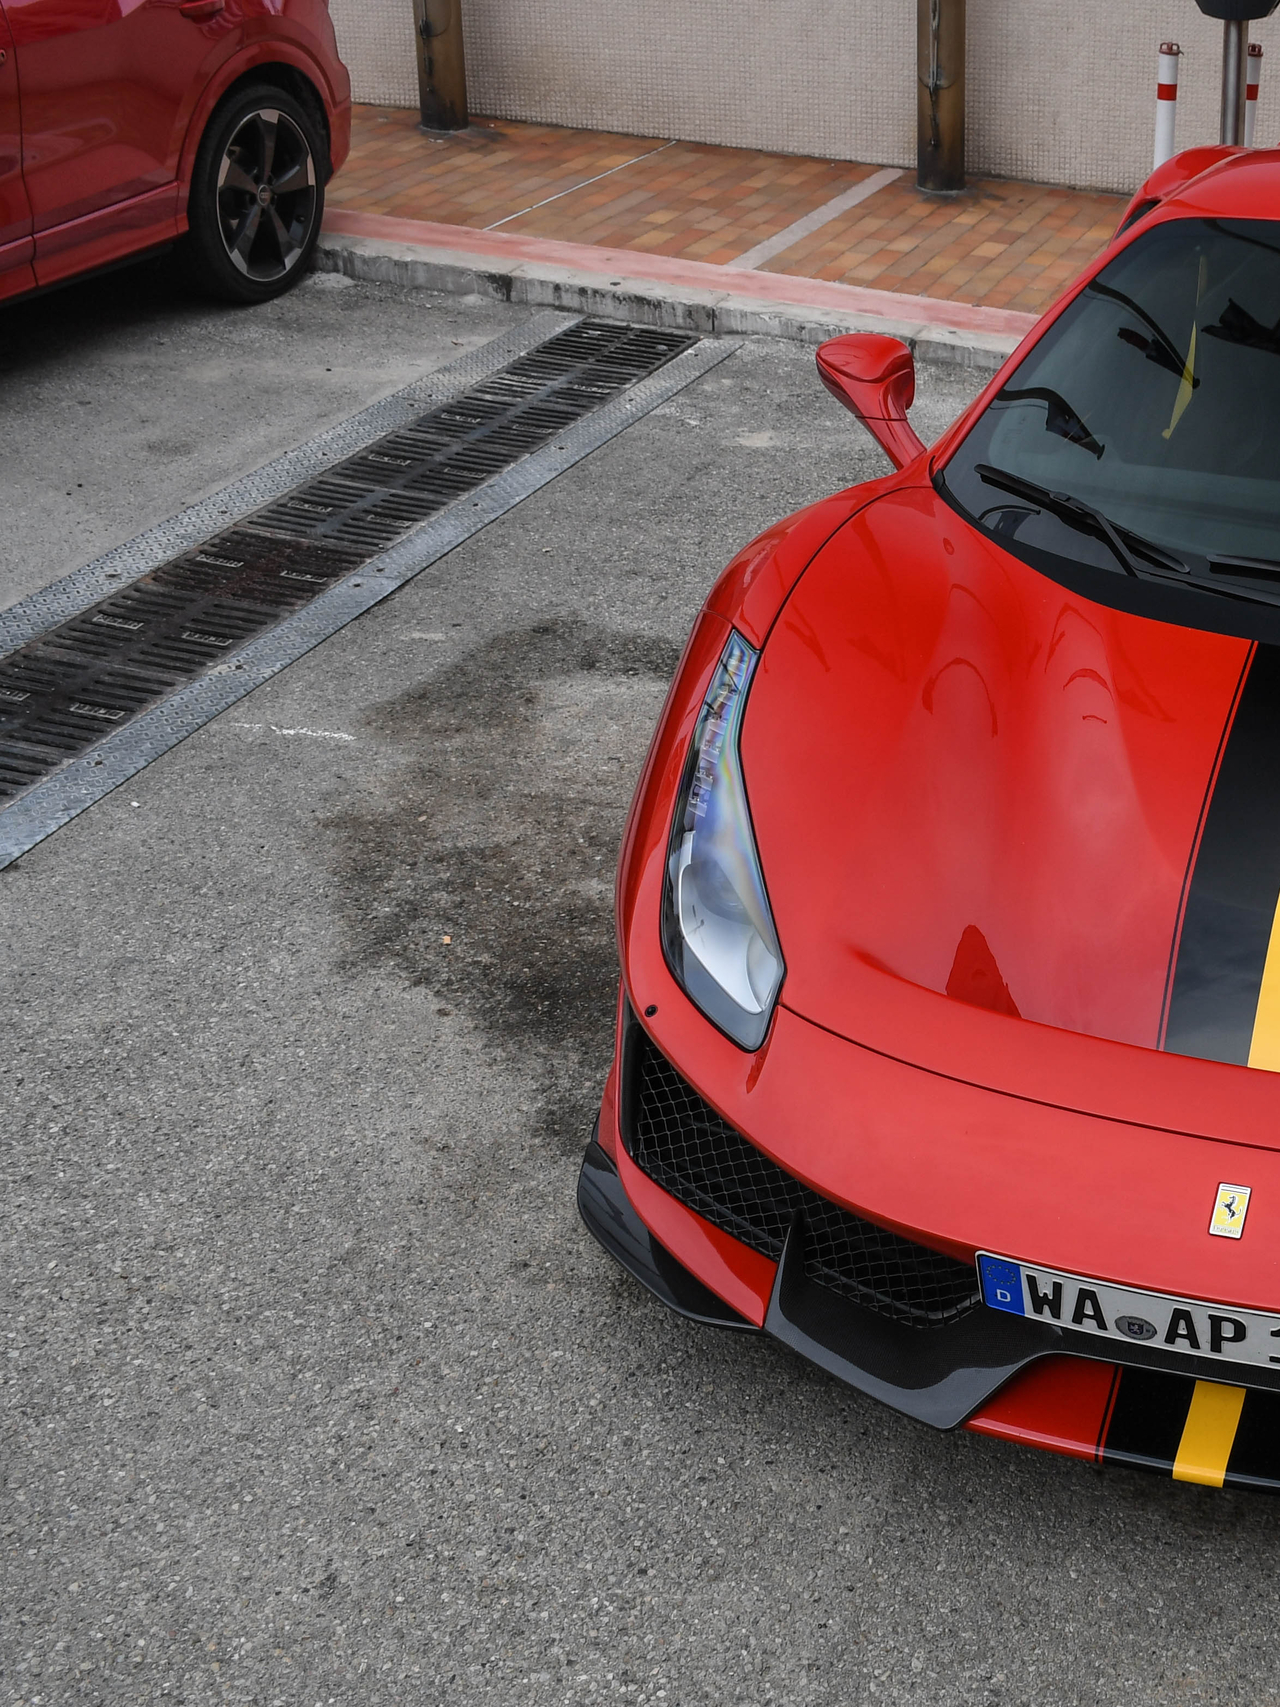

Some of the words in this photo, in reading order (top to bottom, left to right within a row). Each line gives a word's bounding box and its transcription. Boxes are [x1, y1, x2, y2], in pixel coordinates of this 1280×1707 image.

[996, 1288, 1011, 1303] D
[1025, 1274, 1109, 1332] WA
[1164, 1307, 1247, 1354] AP
